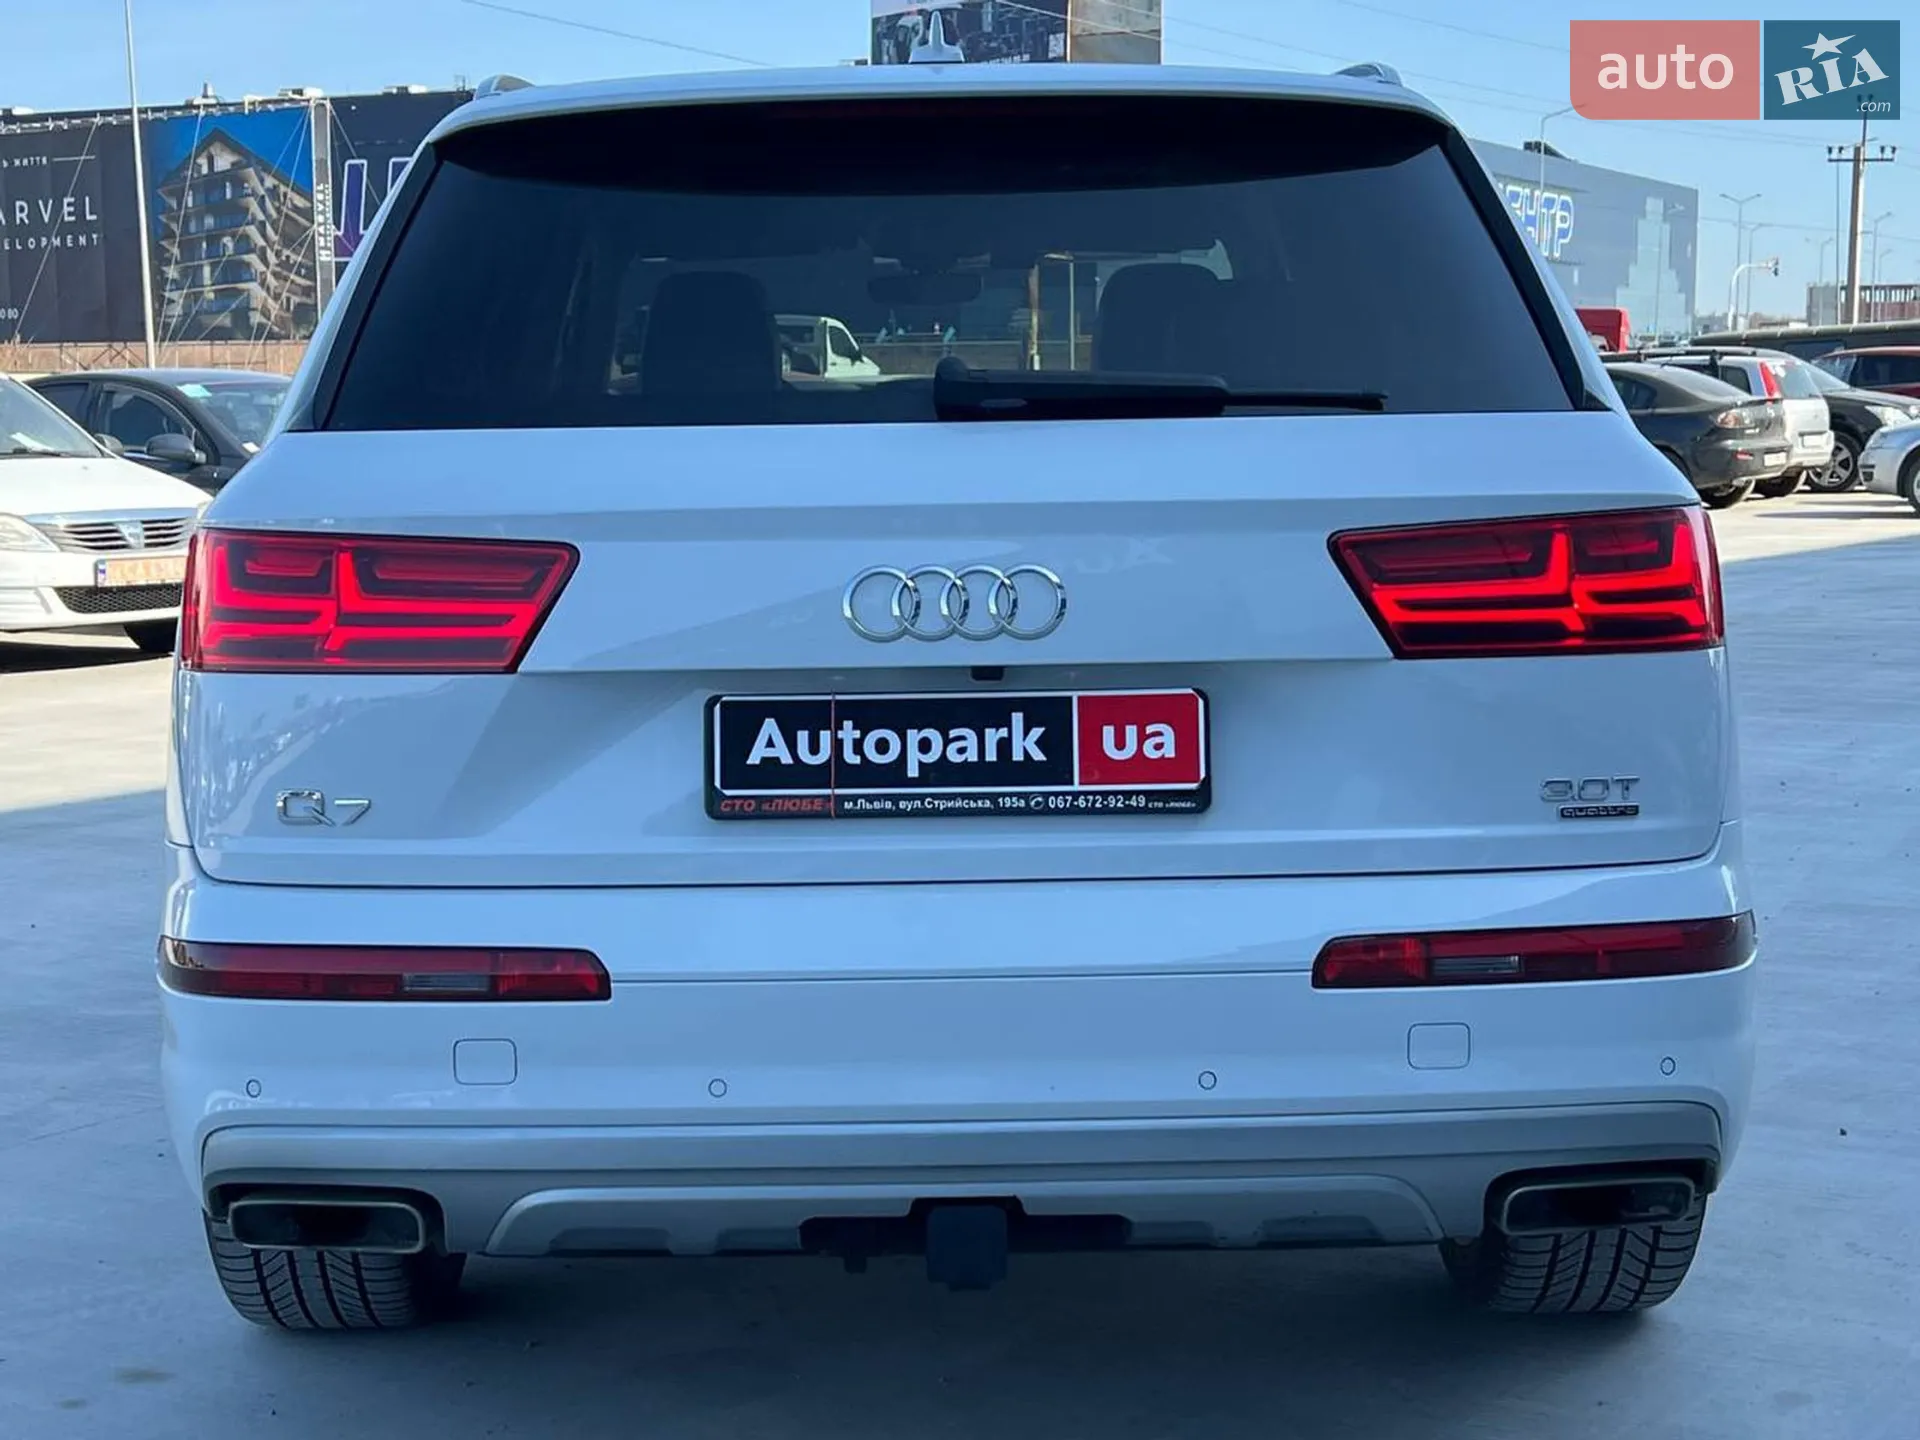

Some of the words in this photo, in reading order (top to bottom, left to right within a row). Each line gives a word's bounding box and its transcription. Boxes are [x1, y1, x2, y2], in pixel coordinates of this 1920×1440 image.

[746, 711, 1046, 778] Autopark
[1102, 722, 1176, 761] ua
[1048, 794, 1146, 809] 067-672-92-49
[1540, 775, 1640, 802] 3.0T
[276, 788, 371, 827] Q7
[1562, 806, 1637, 817] quattro
